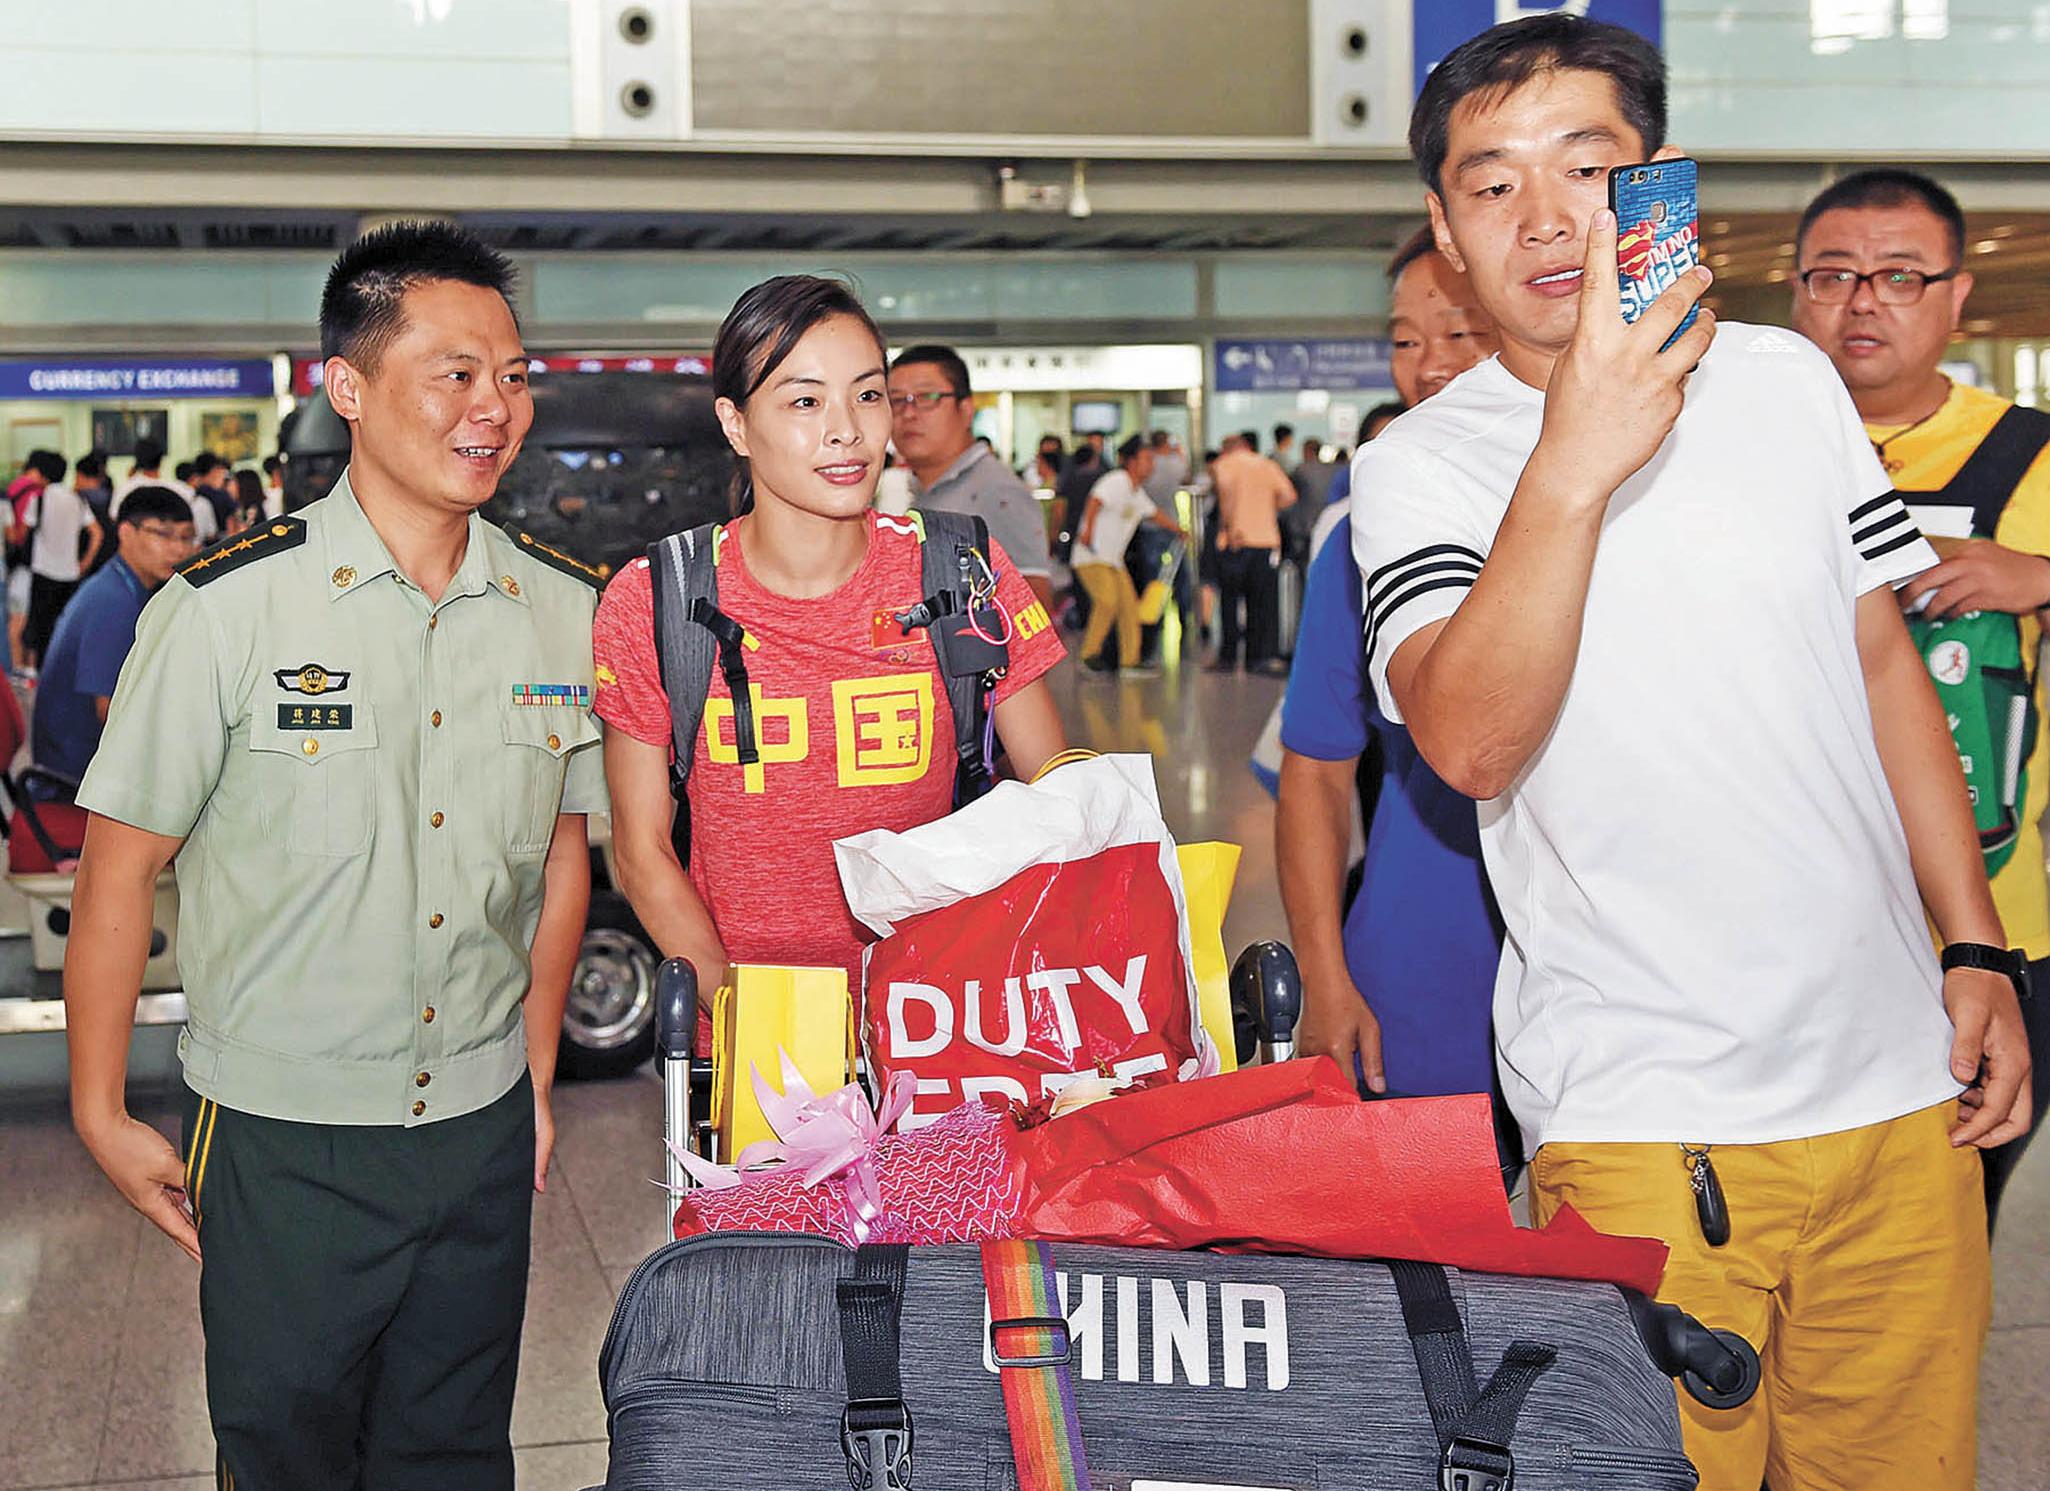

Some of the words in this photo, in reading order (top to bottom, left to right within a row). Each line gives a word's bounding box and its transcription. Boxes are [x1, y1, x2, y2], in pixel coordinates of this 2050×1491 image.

[29, 369, 134, 390] CURRENCY
[137, 368, 240, 389] EXCHANGE
[705, 672, 936, 793] 中国
[886, 955, 1150, 1059] DUTY
[983, 1272, 1289, 1391] HINA
